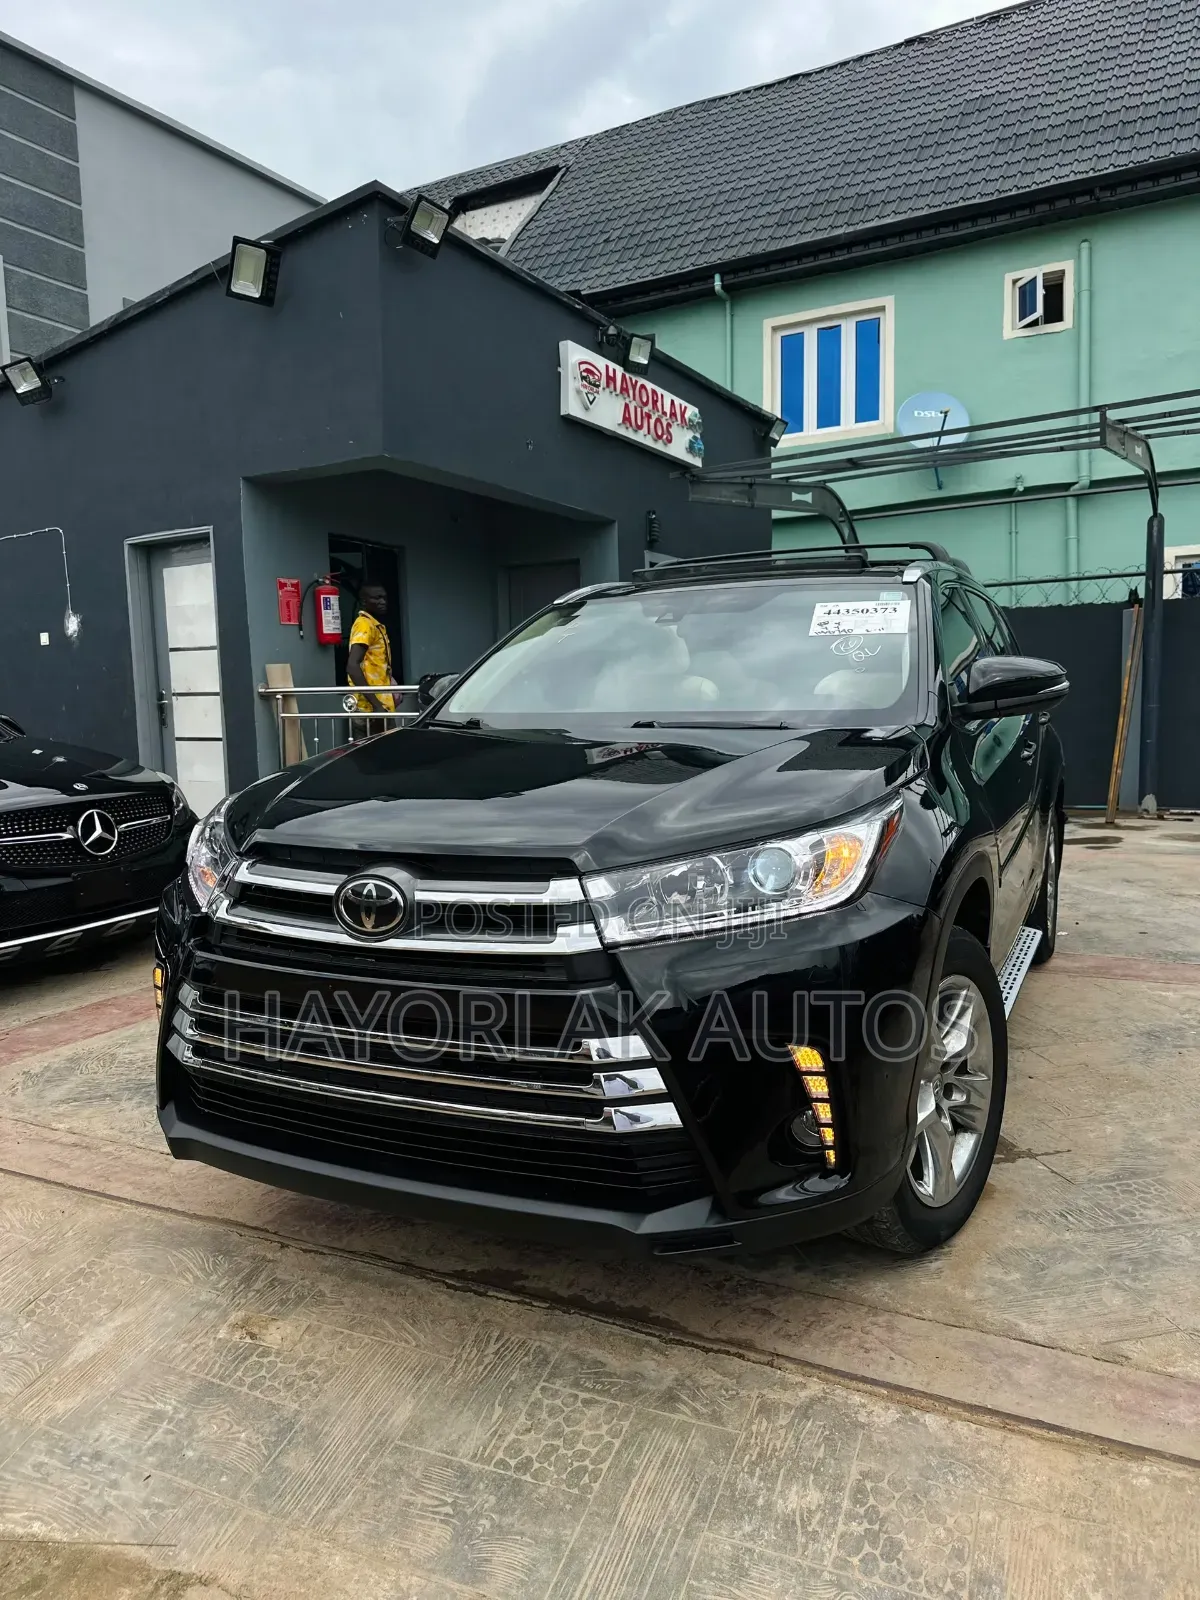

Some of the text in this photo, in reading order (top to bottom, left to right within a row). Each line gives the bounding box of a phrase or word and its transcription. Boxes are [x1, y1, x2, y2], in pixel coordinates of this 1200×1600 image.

[605, 364, 689, 427] HAYORLAK
[621, 402, 674, 444] AUTOS
[823, 607, 898, 616] 44350373
